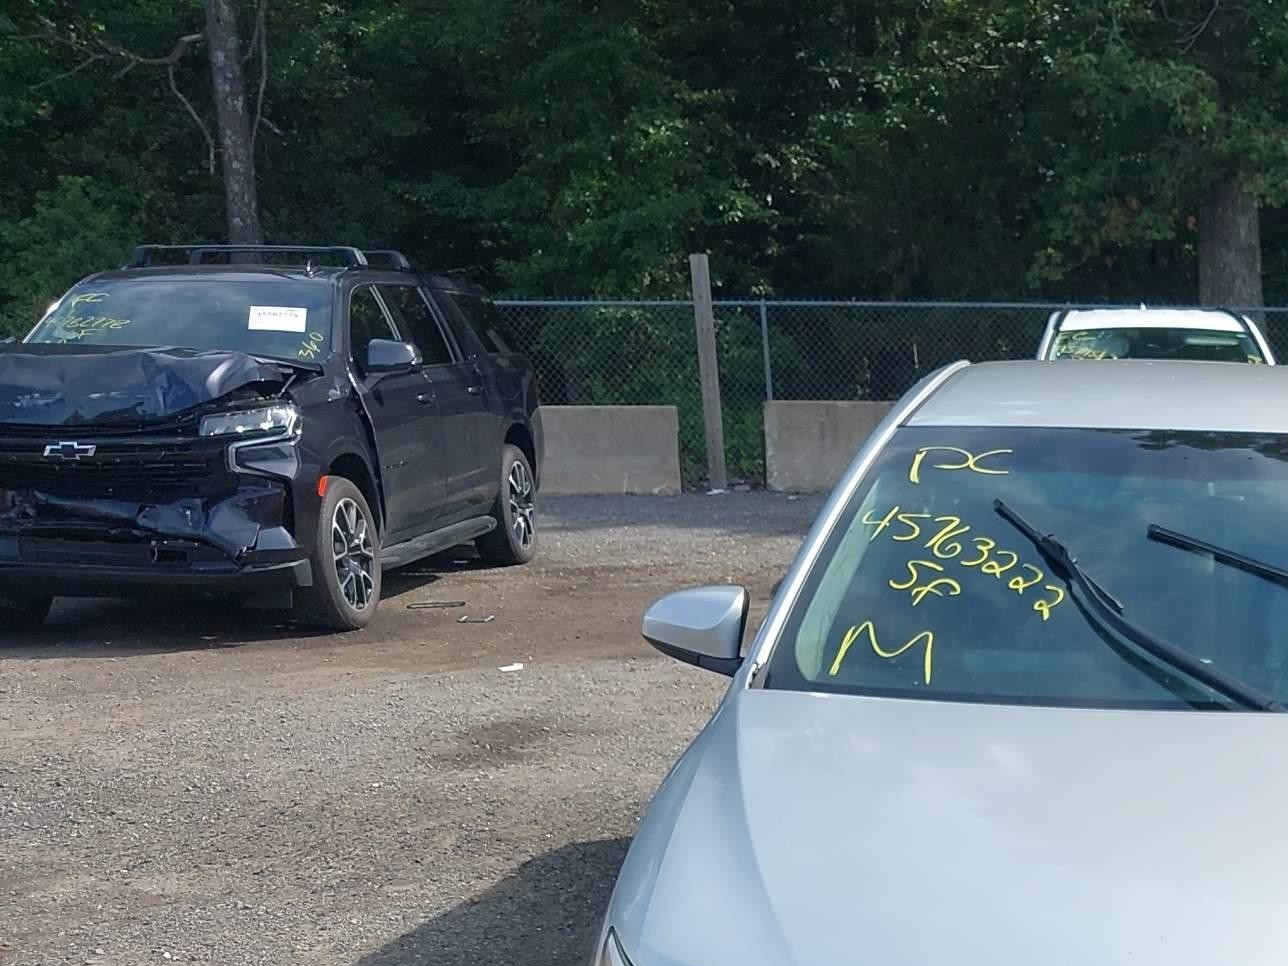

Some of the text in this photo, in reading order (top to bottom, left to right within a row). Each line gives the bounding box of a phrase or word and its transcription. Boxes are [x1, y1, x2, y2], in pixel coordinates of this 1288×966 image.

[298, 331, 324, 360] 360
[908, 445, 1014, 484] PC
[861, 505, 1065, 622] 45763222
[828, 620, 933, 685] M
